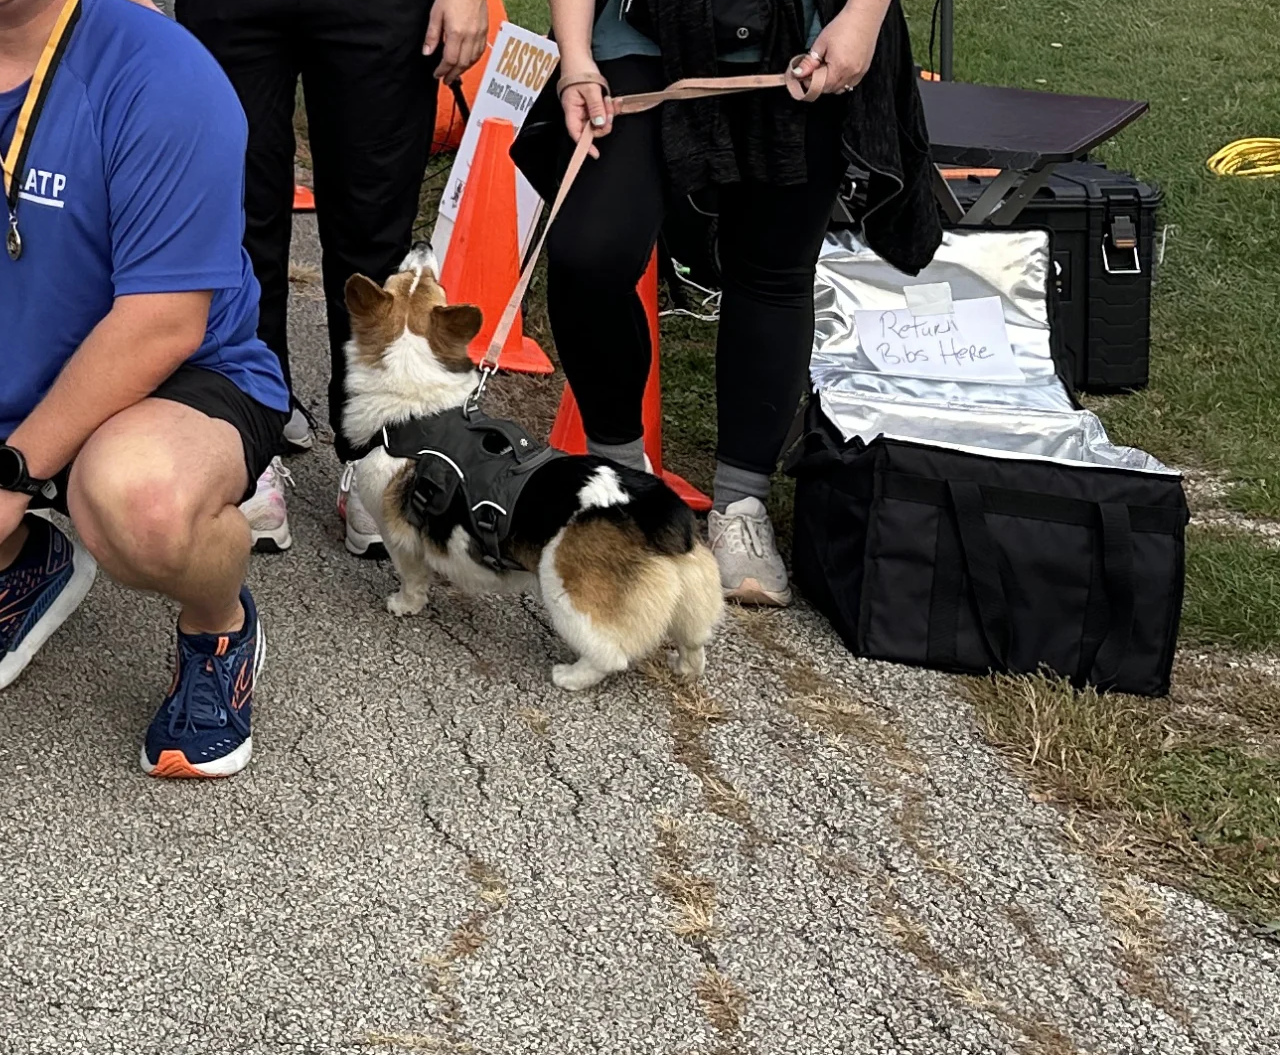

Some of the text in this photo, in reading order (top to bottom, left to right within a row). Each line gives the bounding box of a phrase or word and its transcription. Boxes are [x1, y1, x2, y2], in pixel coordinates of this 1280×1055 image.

[486, 77, 505, 99] Race
[501, 83, 523, 111] Timing
[19, 168, 67, 198] ATP
[876, 342, 929, 365] Bibs
